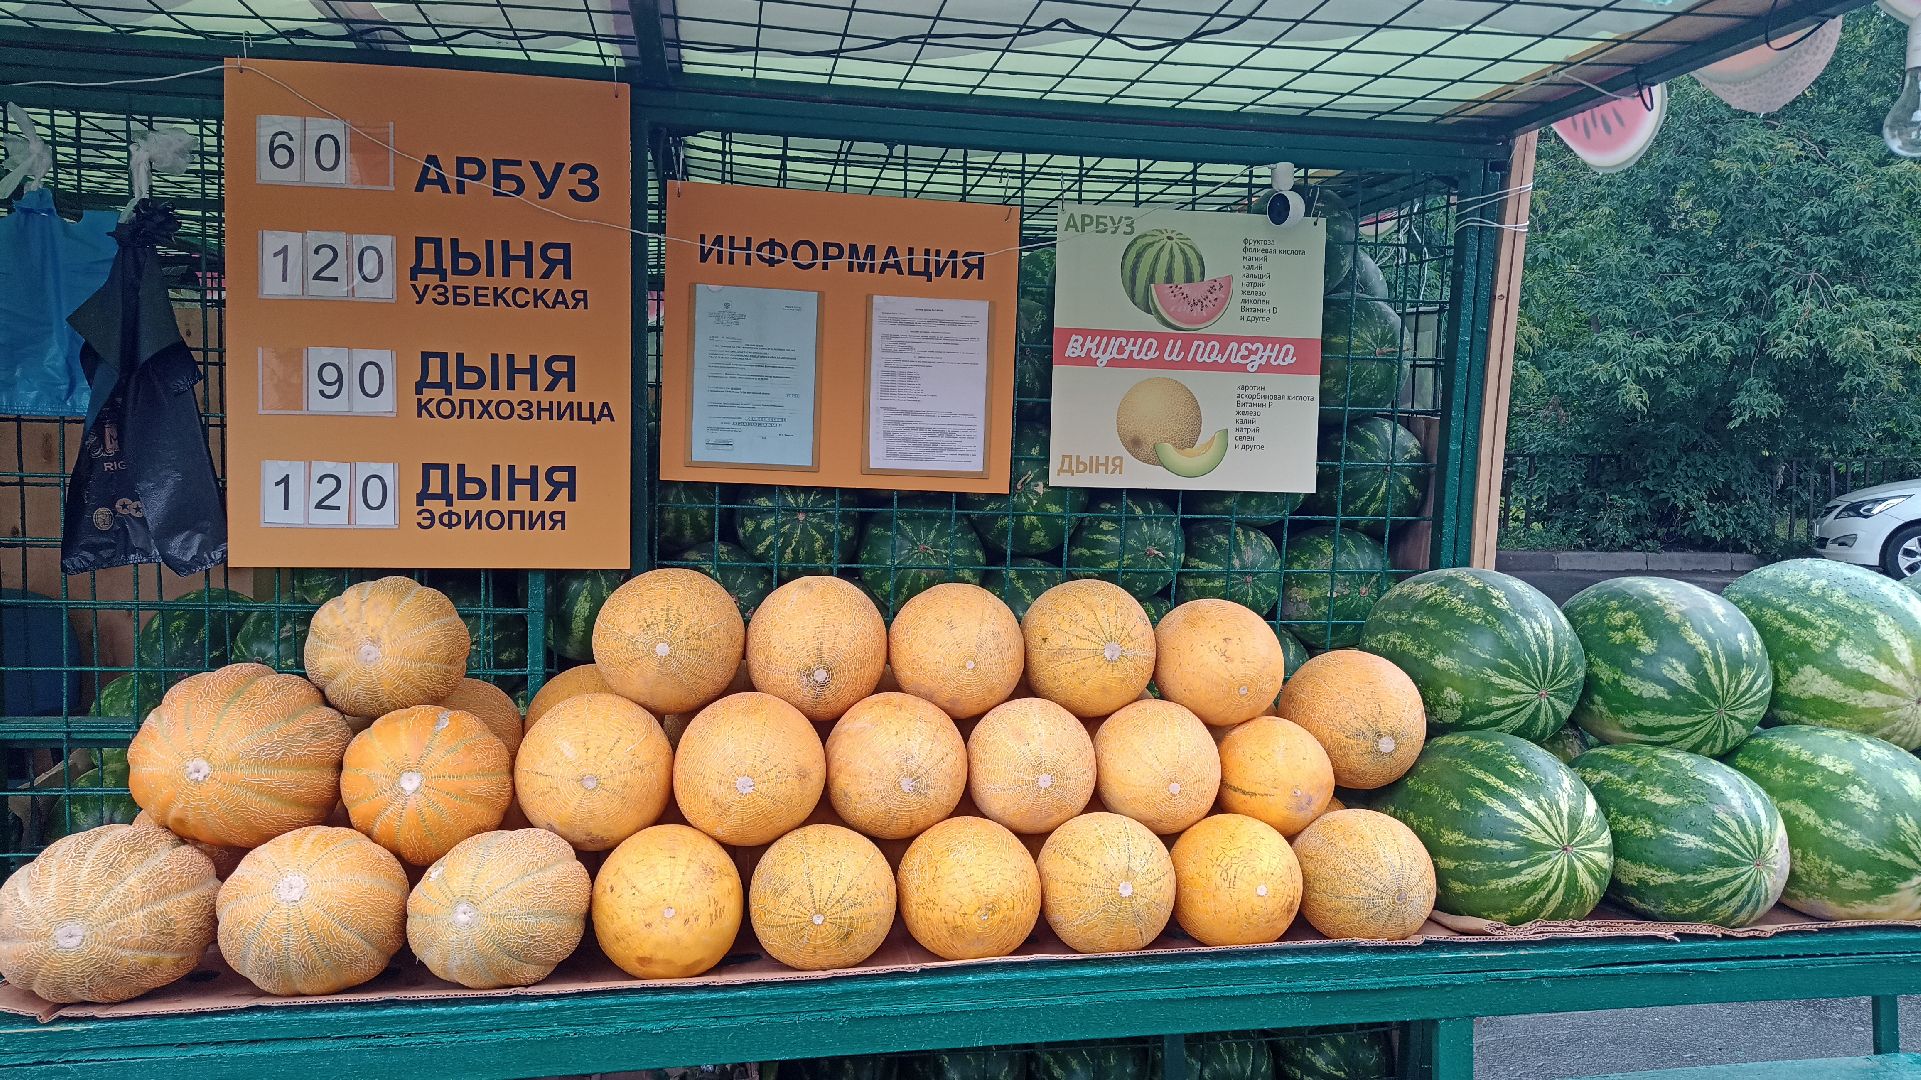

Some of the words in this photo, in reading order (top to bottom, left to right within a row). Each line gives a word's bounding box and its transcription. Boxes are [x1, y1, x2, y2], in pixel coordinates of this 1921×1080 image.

[267, 130, 342, 172] 60
[414, 154, 601, 203] АРБУЗ
[1063, 212, 1136, 236] АРБУЗ
[272, 243, 385, 284] 120
[409, 236, 572, 282] ДЫНЯ
[699, 233, 985, 283] ИНФОРМАЦИЯ
[410, 283, 589, 310] УЗБЕКСКАЯ
[316, 360, 385, 400] 90
[414, 350, 577, 396] ДЫНЯ
[416, 397, 616, 425] КОЛХОЗНИЦА
[416, 462, 578, 507] ДЫНЯ
[1057, 455, 1123, 477] ДЫНЯ
[273, 472, 389, 511] 120
[415, 508, 567, 531] ЭФИОПИЯ
